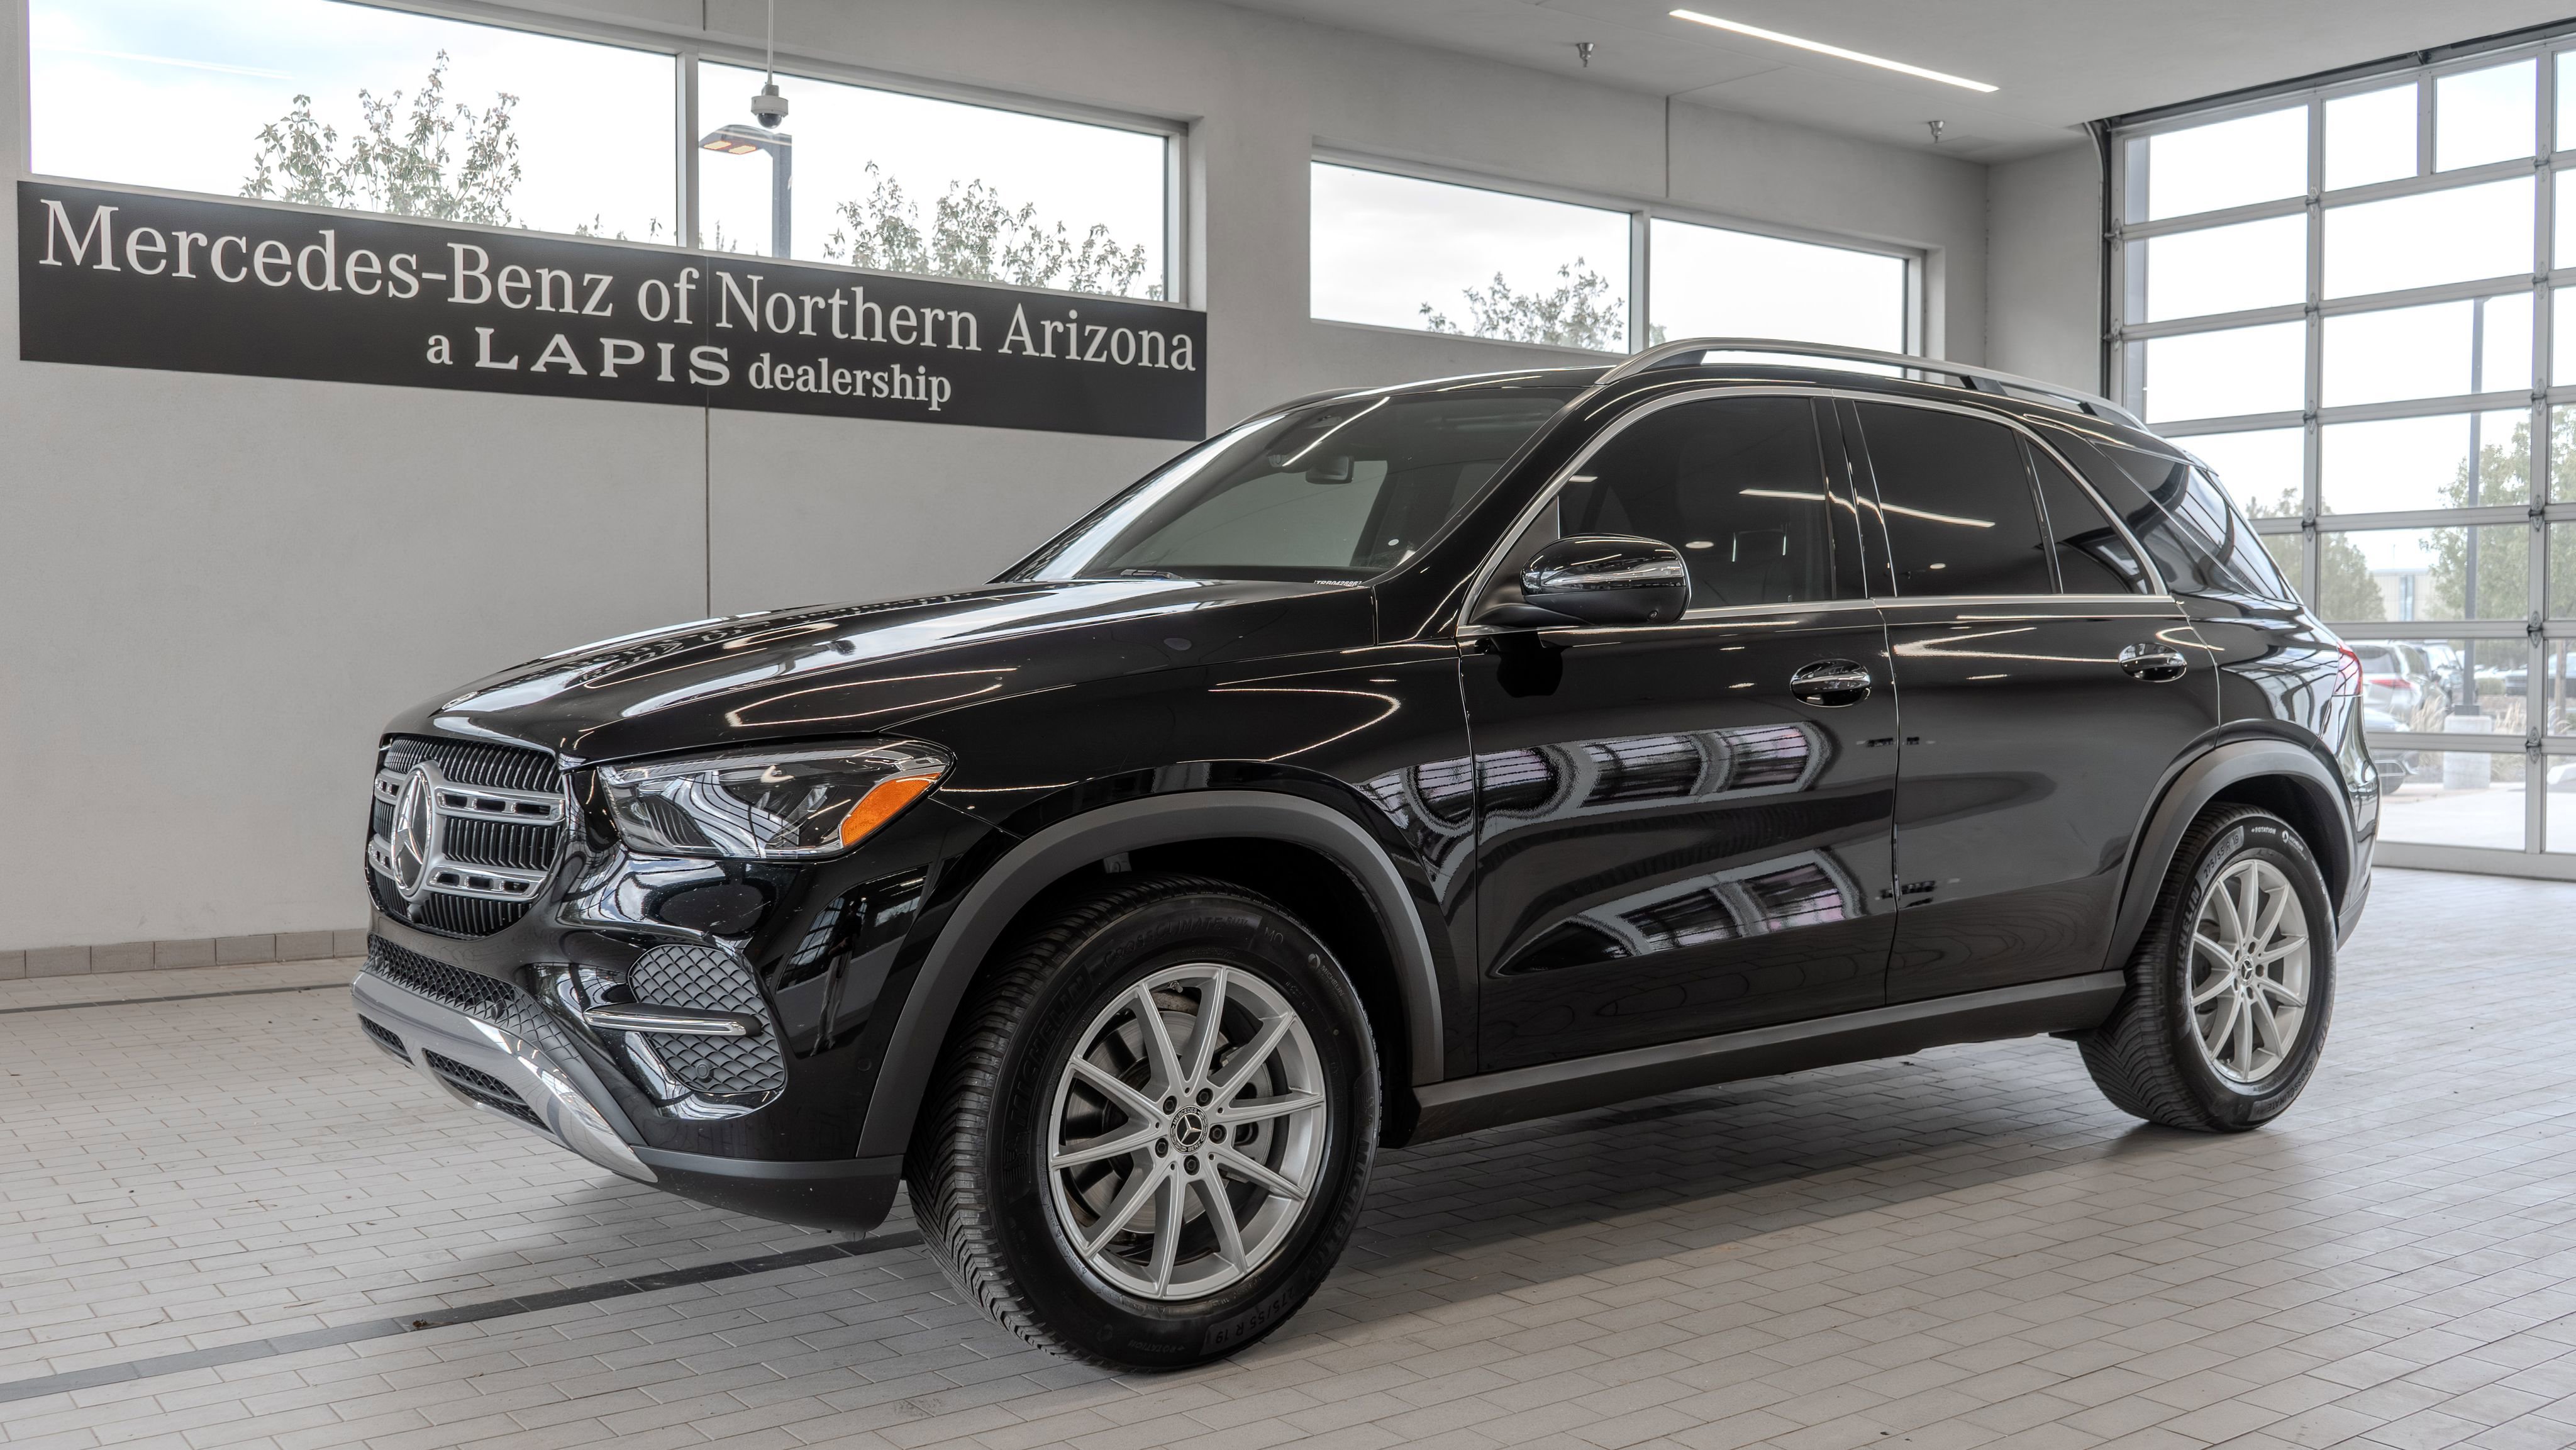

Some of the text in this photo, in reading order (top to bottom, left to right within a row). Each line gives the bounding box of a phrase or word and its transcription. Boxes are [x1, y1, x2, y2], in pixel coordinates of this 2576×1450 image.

[38, 198, 1196, 371] Mercedes-Benz of Northern Arizona
[426, 326, 952, 411] a LAPIS dealership
[2203, 835, 2239, 879] 275/55 R 19
[1321, 965, 1344, 997] MICHELIN
[1010, 974, 1088, 1129] MICHELIN
[1172, 1107, 1197, 1125] MERCEDES
[1187, 1141, 1202, 1152] BENZ
[1215, 1327, 1229, 1344] 19
[1235, 1322, 1245, 1336] R
